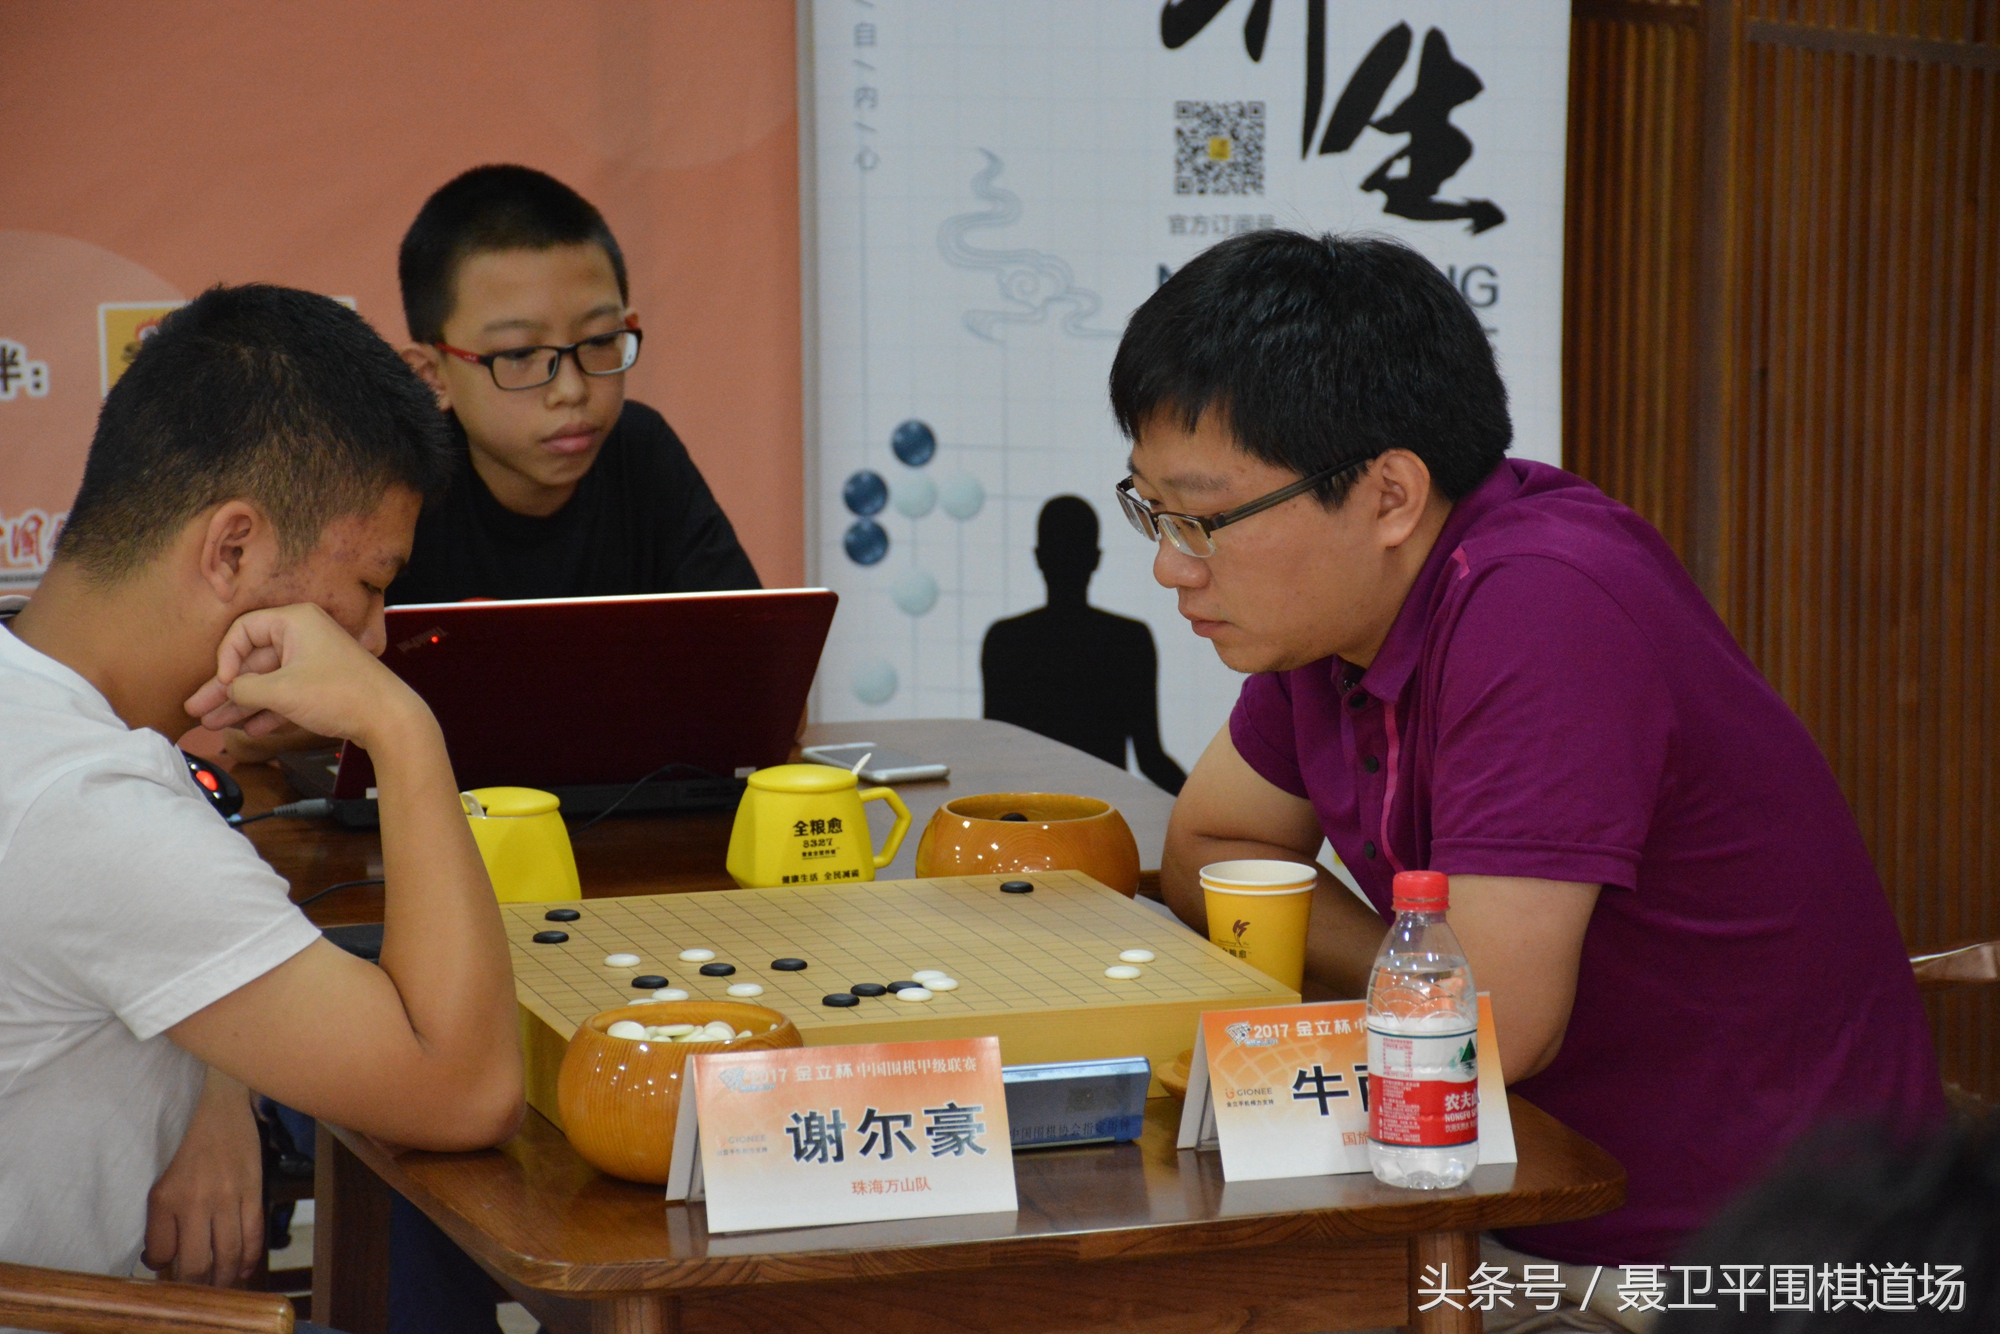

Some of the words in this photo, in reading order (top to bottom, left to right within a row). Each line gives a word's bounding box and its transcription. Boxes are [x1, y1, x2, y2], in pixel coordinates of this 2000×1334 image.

[793, 817, 843, 837] 全粮愈
[1254, 1023, 1289, 1038] 2017
[1296, 1018, 1351, 1037] 金立杯
[857, 1057, 977, 1078] 中国围棋甲级联赛
[1237, 1087, 1273, 1096] GIONEE
[785, 1102, 988, 1165] 谢尔豪
[851, 1176, 932, 1196] 珠海万山队
